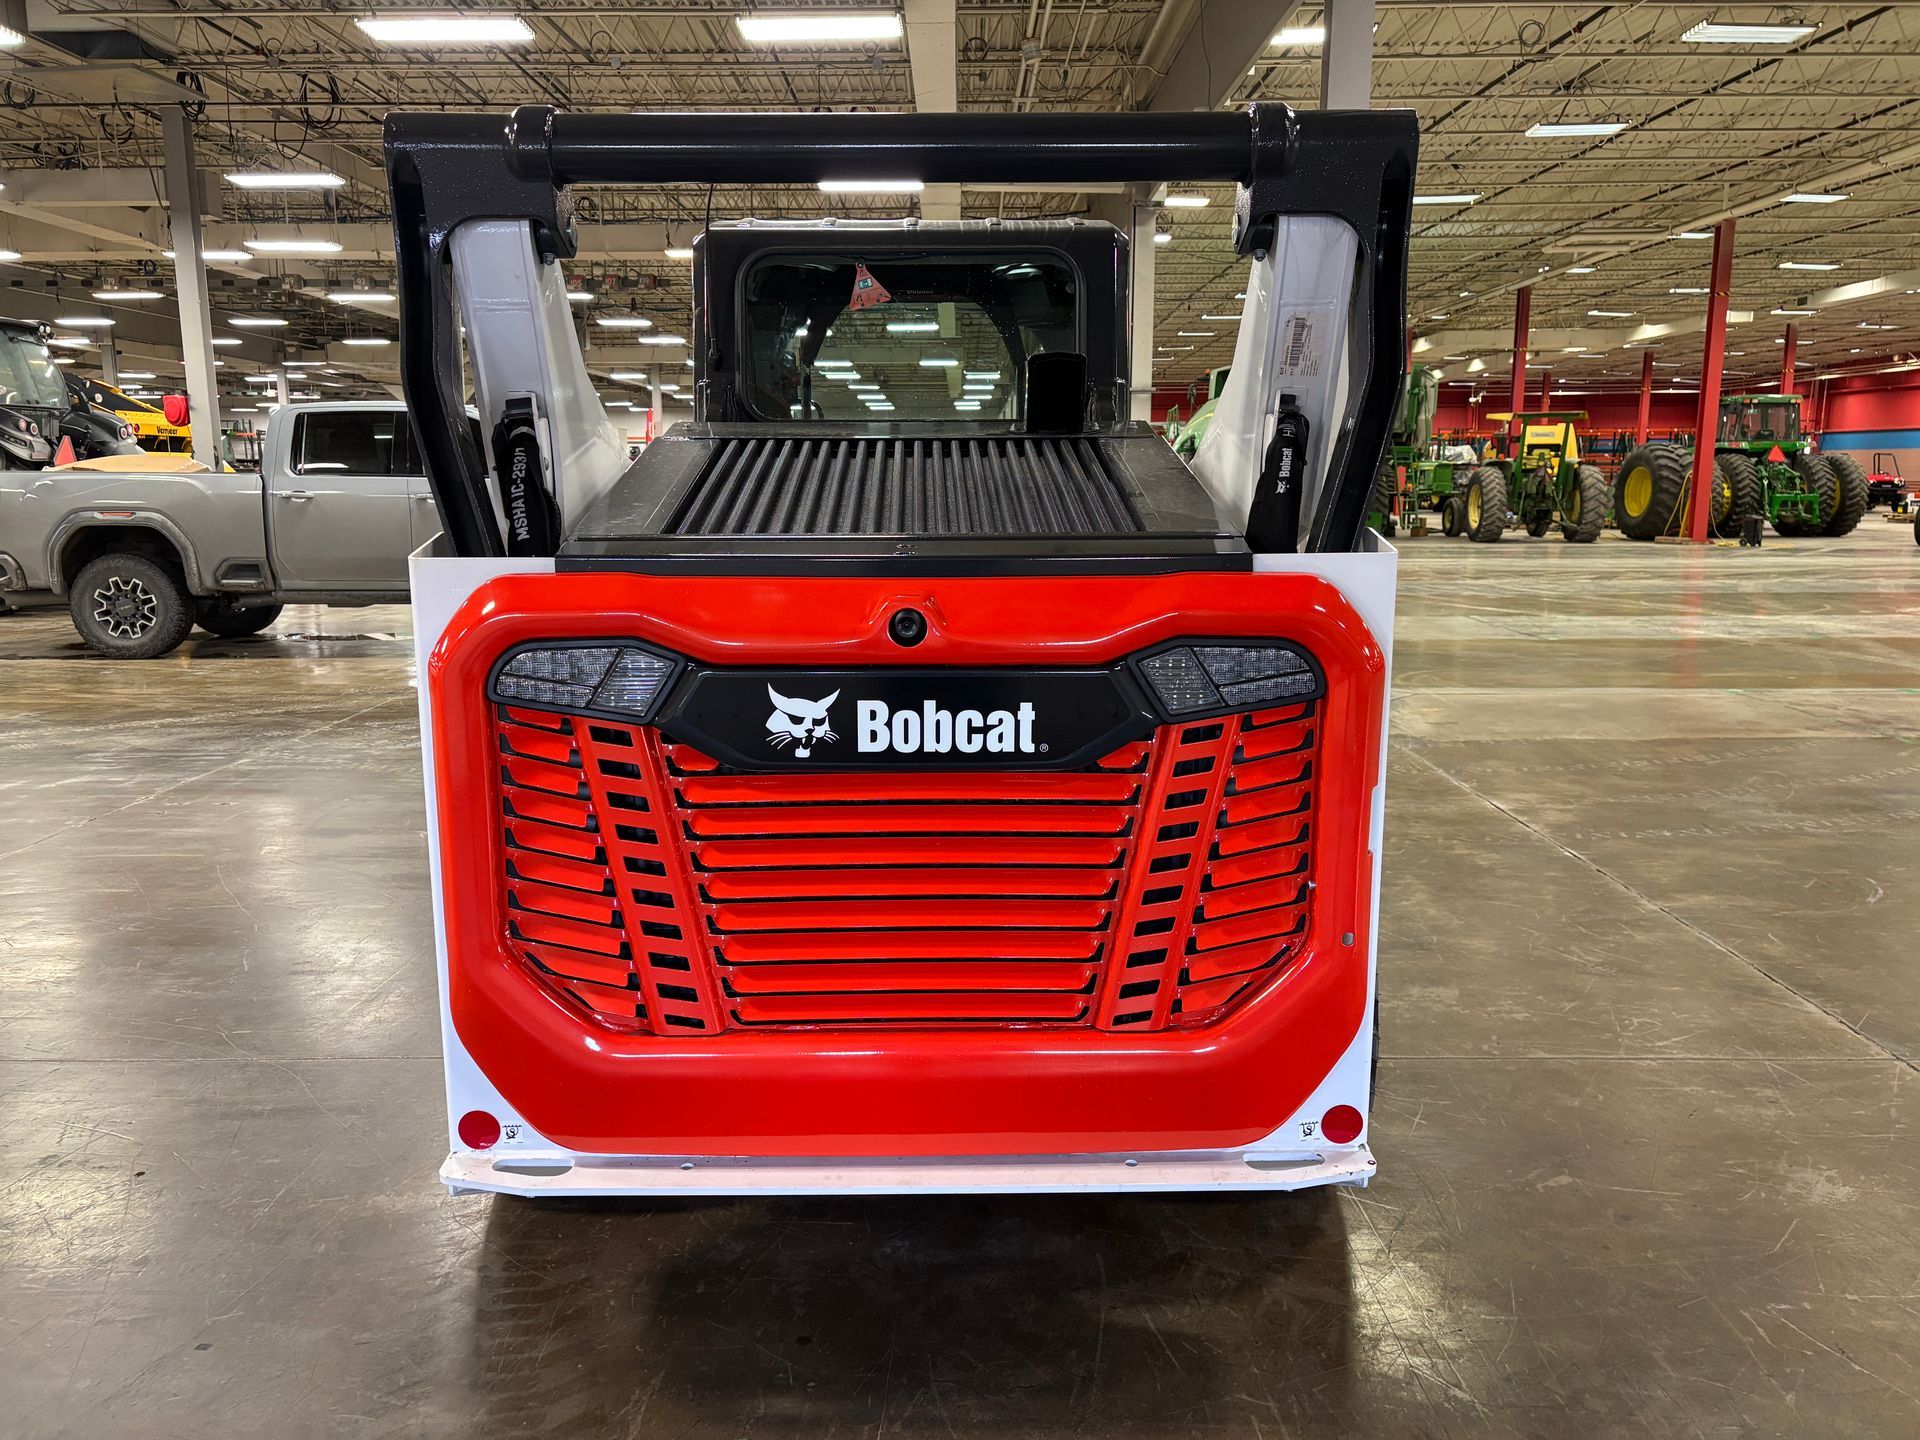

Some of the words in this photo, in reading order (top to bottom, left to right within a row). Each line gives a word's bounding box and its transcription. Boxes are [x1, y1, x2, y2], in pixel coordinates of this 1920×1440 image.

[1279, 448, 1293, 478] Bobcat
[511, 499, 530, 542] MSHA
[857, 700, 1036, 753] Bobcat
